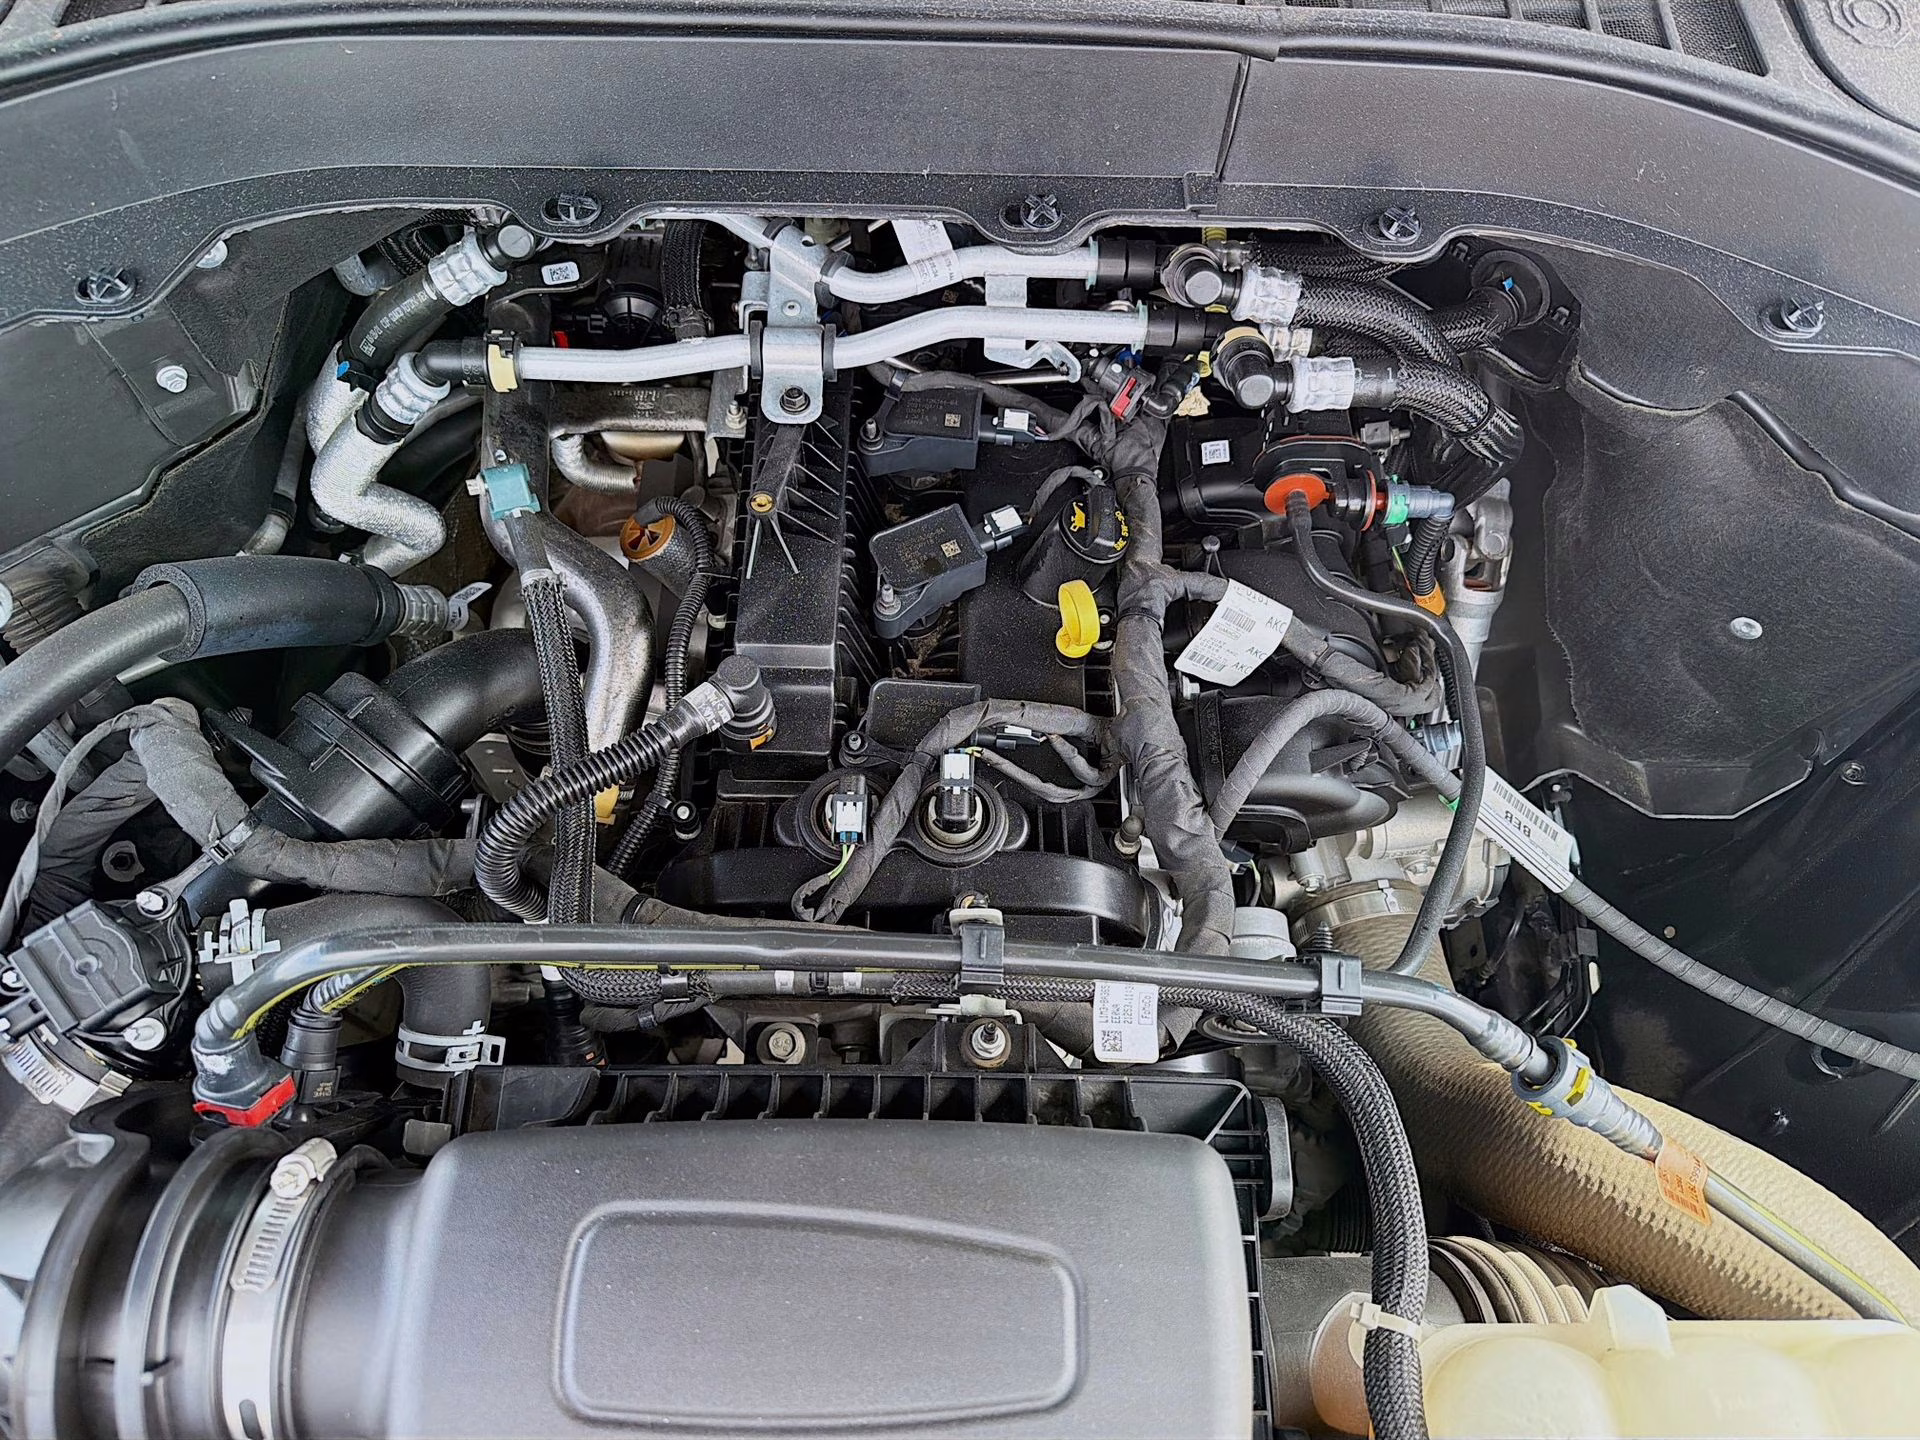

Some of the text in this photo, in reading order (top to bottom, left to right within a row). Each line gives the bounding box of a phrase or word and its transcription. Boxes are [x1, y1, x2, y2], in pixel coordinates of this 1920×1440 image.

[1113, 537, 1127, 551] SAE
[1265, 616, 1288, 634] AKC
[1246, 646, 1268, 661] AKC
[1231, 661, 1254, 675] AKC
[1504, 810, 1532, 839] BEB
